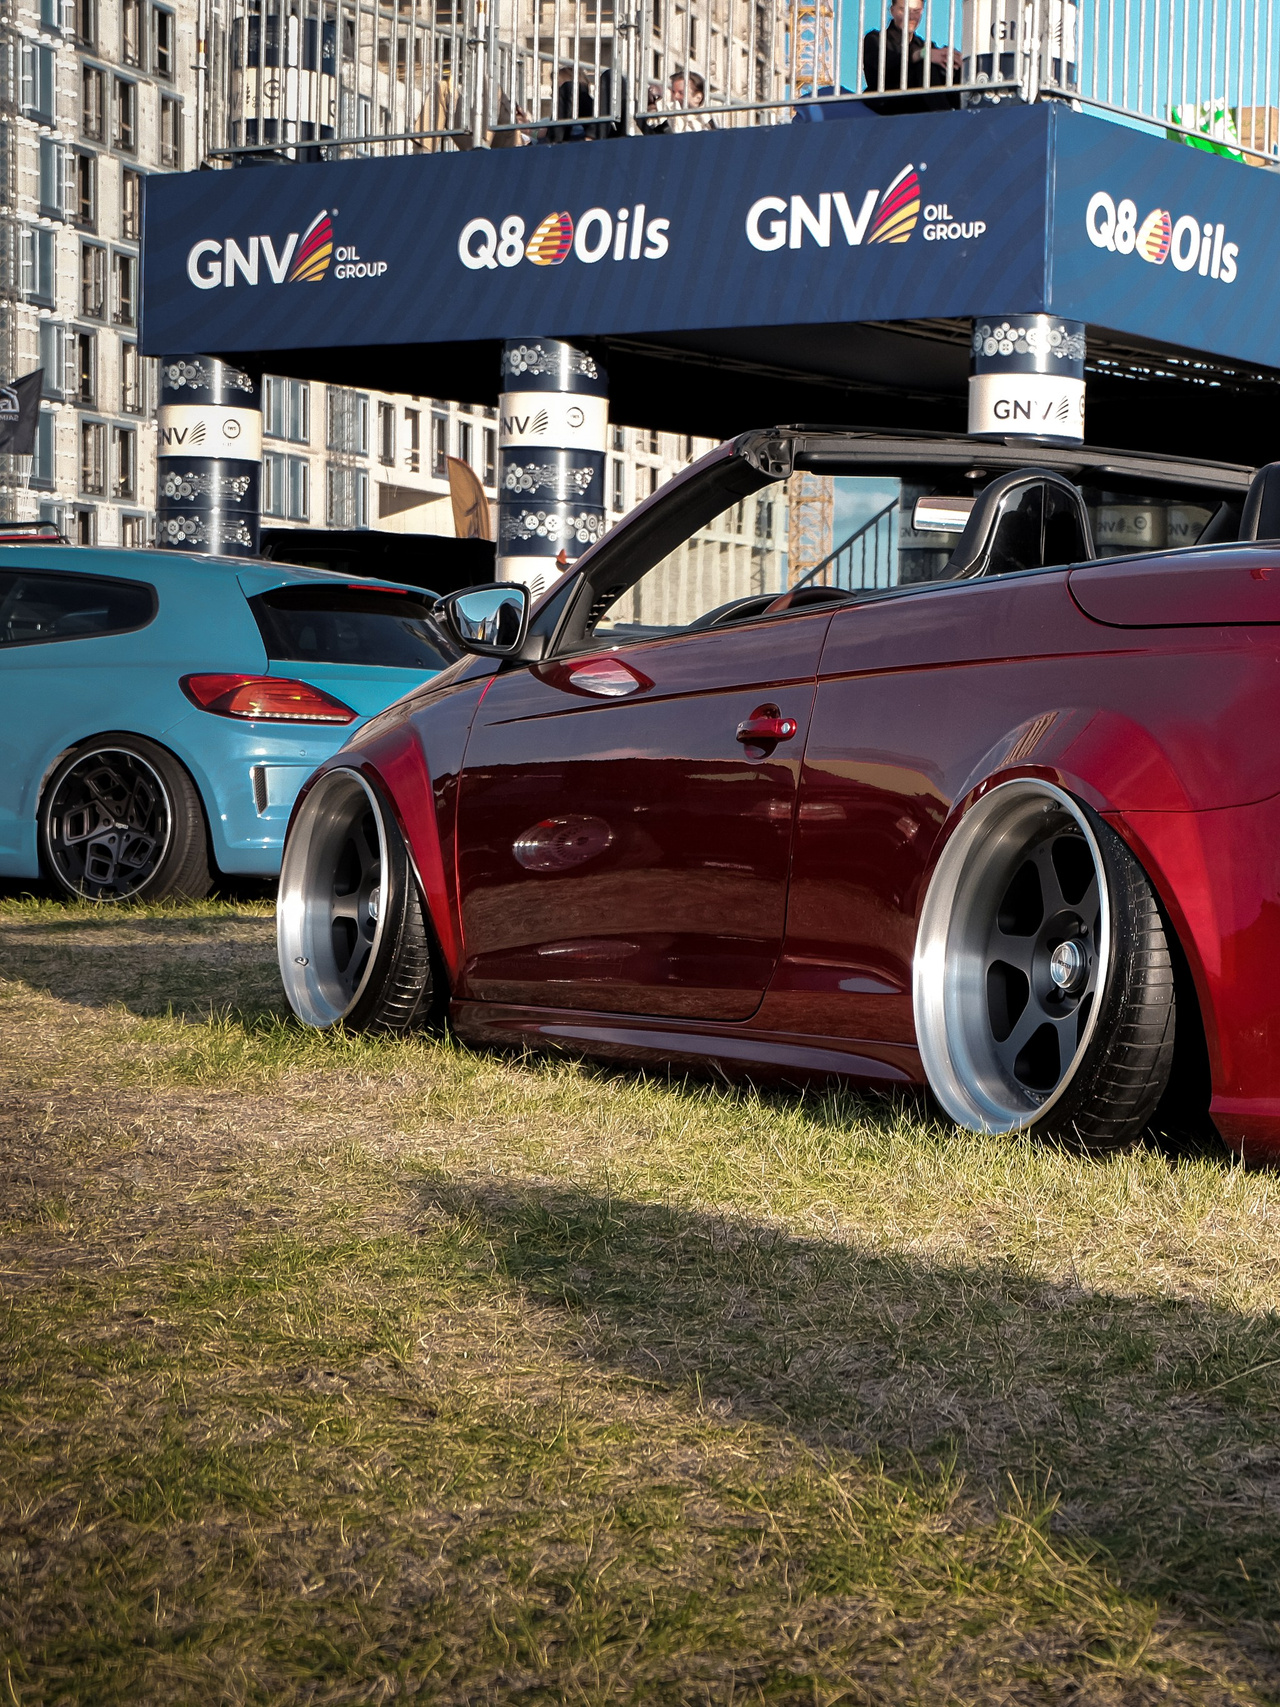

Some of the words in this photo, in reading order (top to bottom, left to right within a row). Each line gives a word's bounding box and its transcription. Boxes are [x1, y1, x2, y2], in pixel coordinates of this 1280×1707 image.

[747, 189, 880, 252] GNV
[923, 204, 953, 221] OIL
[923, 221, 987, 241] GROUP
[335, 246, 360, 261] OIL
[458, 215, 525, 270] Q8
[574, 203, 670, 264] Oils
[1086, 191, 1137, 255] Q8
[1171, 214, 1239, 284] Oils
[187, 233, 299, 289] GNV
[334, 261, 388, 279] GROUP
